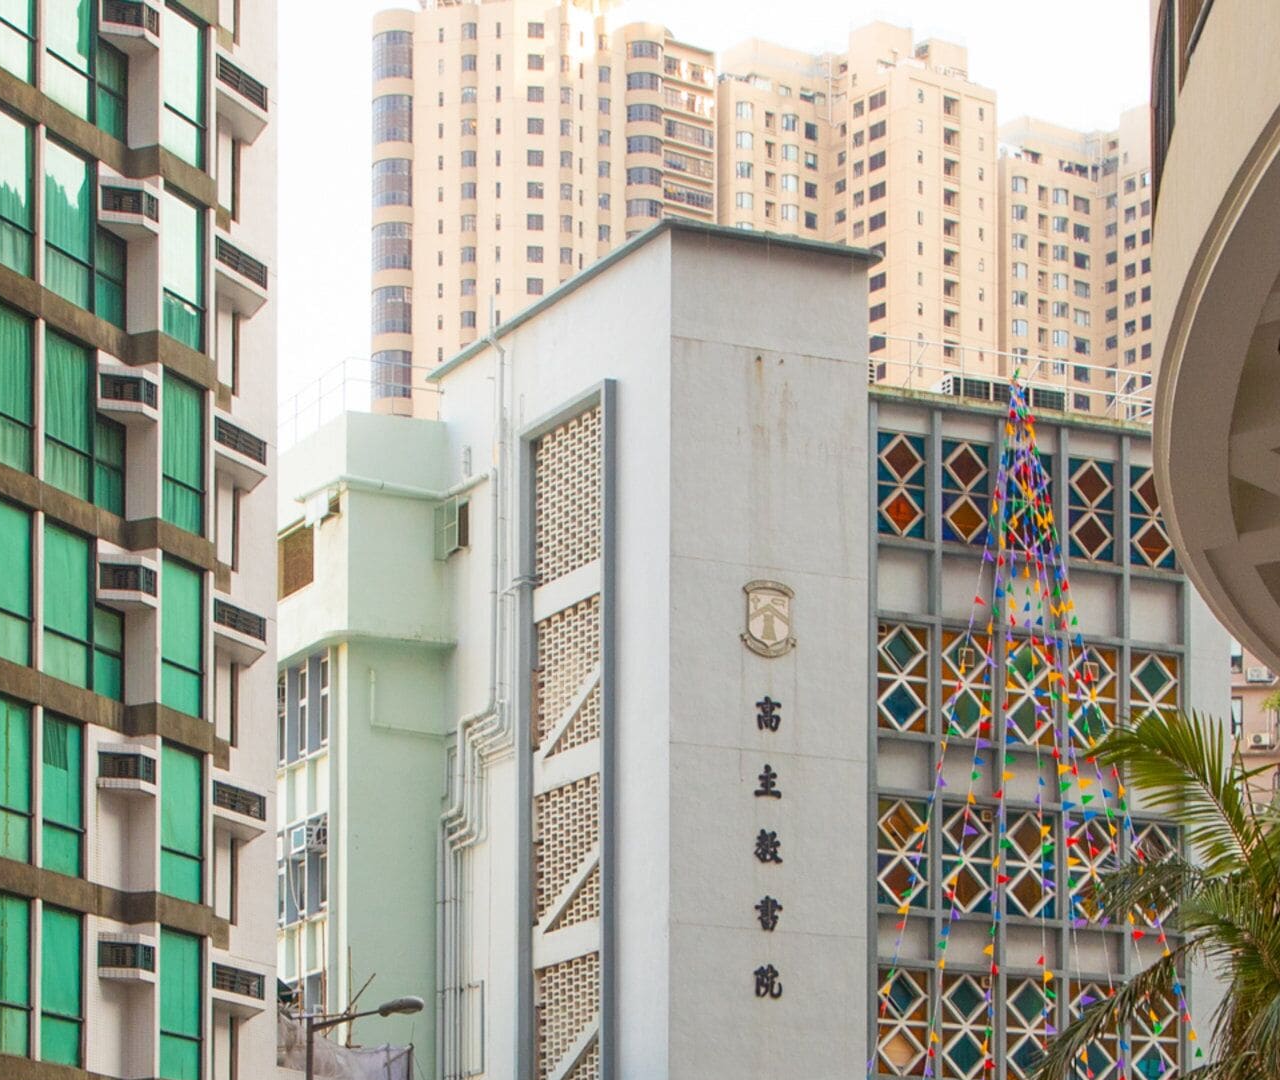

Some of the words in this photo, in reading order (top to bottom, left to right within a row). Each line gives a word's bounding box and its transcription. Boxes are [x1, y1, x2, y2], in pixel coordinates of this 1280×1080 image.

[753, 697, 783, 999] 高主教書院
